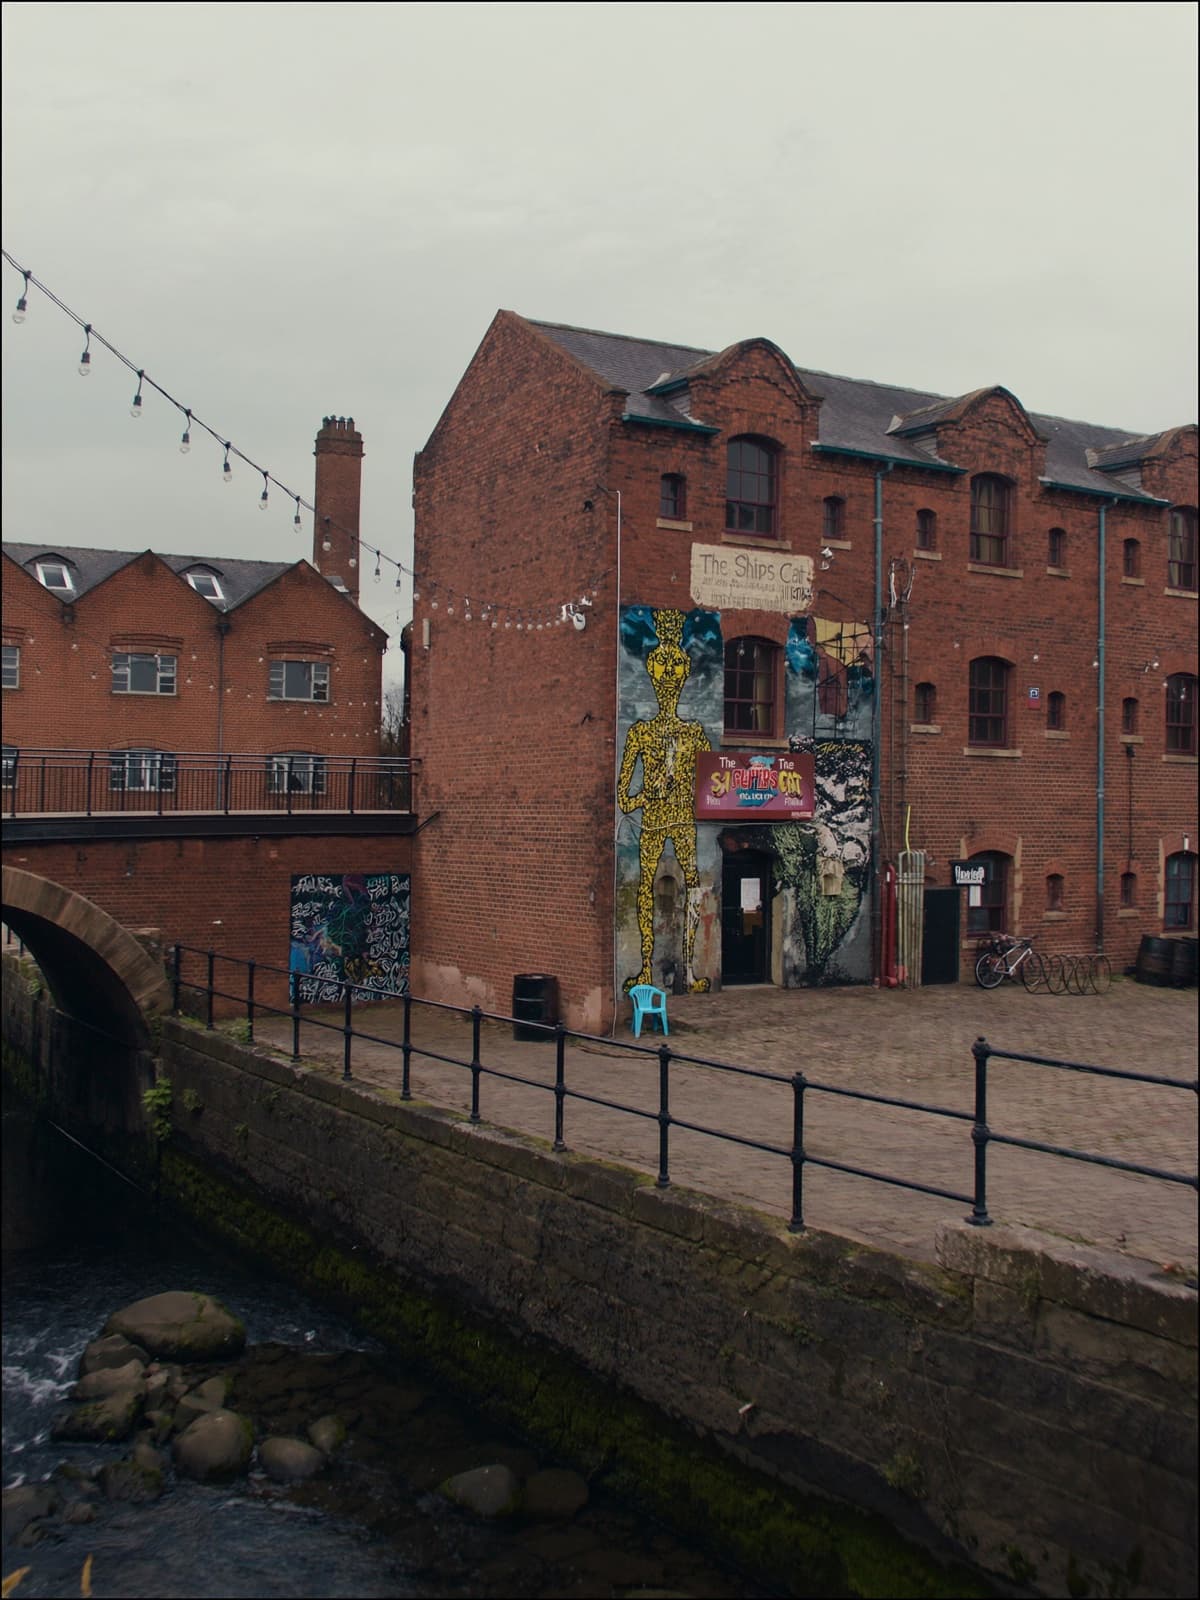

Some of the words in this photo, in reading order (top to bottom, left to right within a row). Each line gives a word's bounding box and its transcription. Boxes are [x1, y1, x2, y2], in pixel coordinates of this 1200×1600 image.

[699, 553, 729, 577] The
[735, 552, 776, 581] Ships
[780, 562, 808, 585] Cat
[719, 756, 737, 769] The
